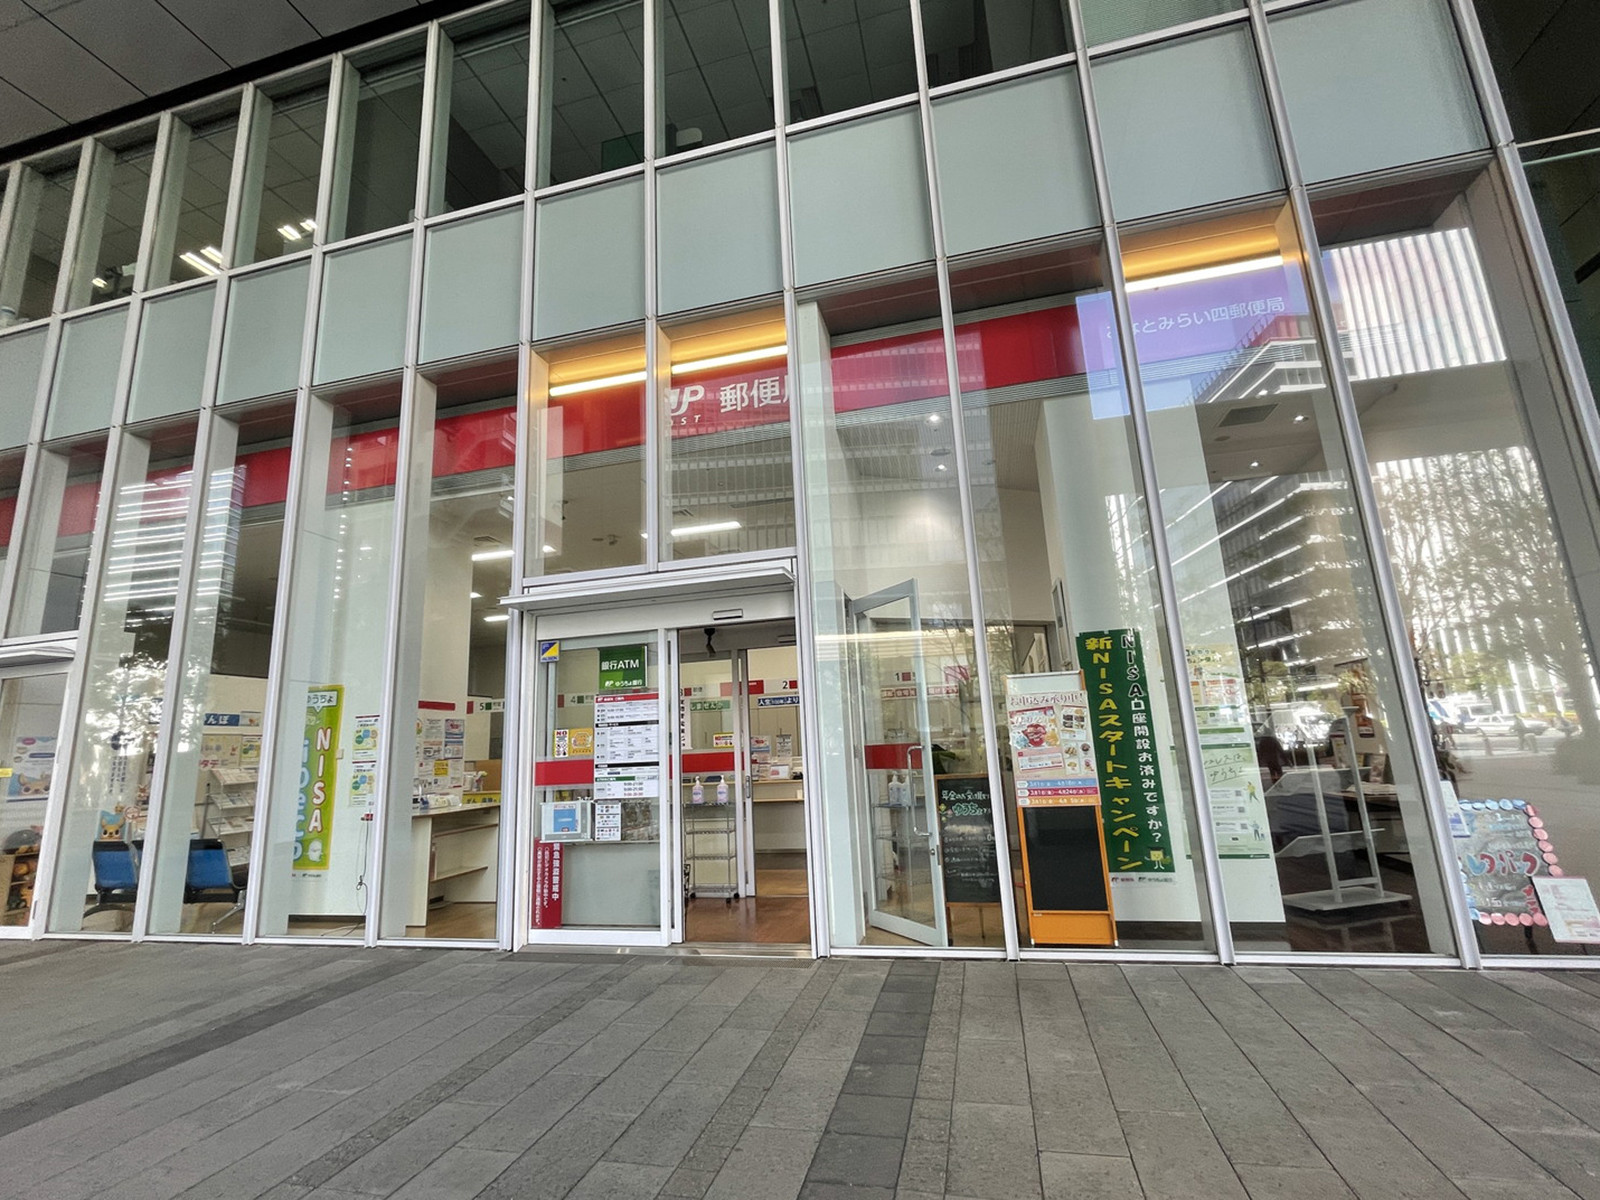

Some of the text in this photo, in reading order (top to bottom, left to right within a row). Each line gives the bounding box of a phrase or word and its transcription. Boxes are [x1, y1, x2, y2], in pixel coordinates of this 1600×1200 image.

[719, 374, 790, 413] 郵便
[601, 659, 640, 671] 銀行ATM
[307, 726, 333, 833] NISA
[1084, 636, 1143, 870] 新NISAスタートキャンペーン
